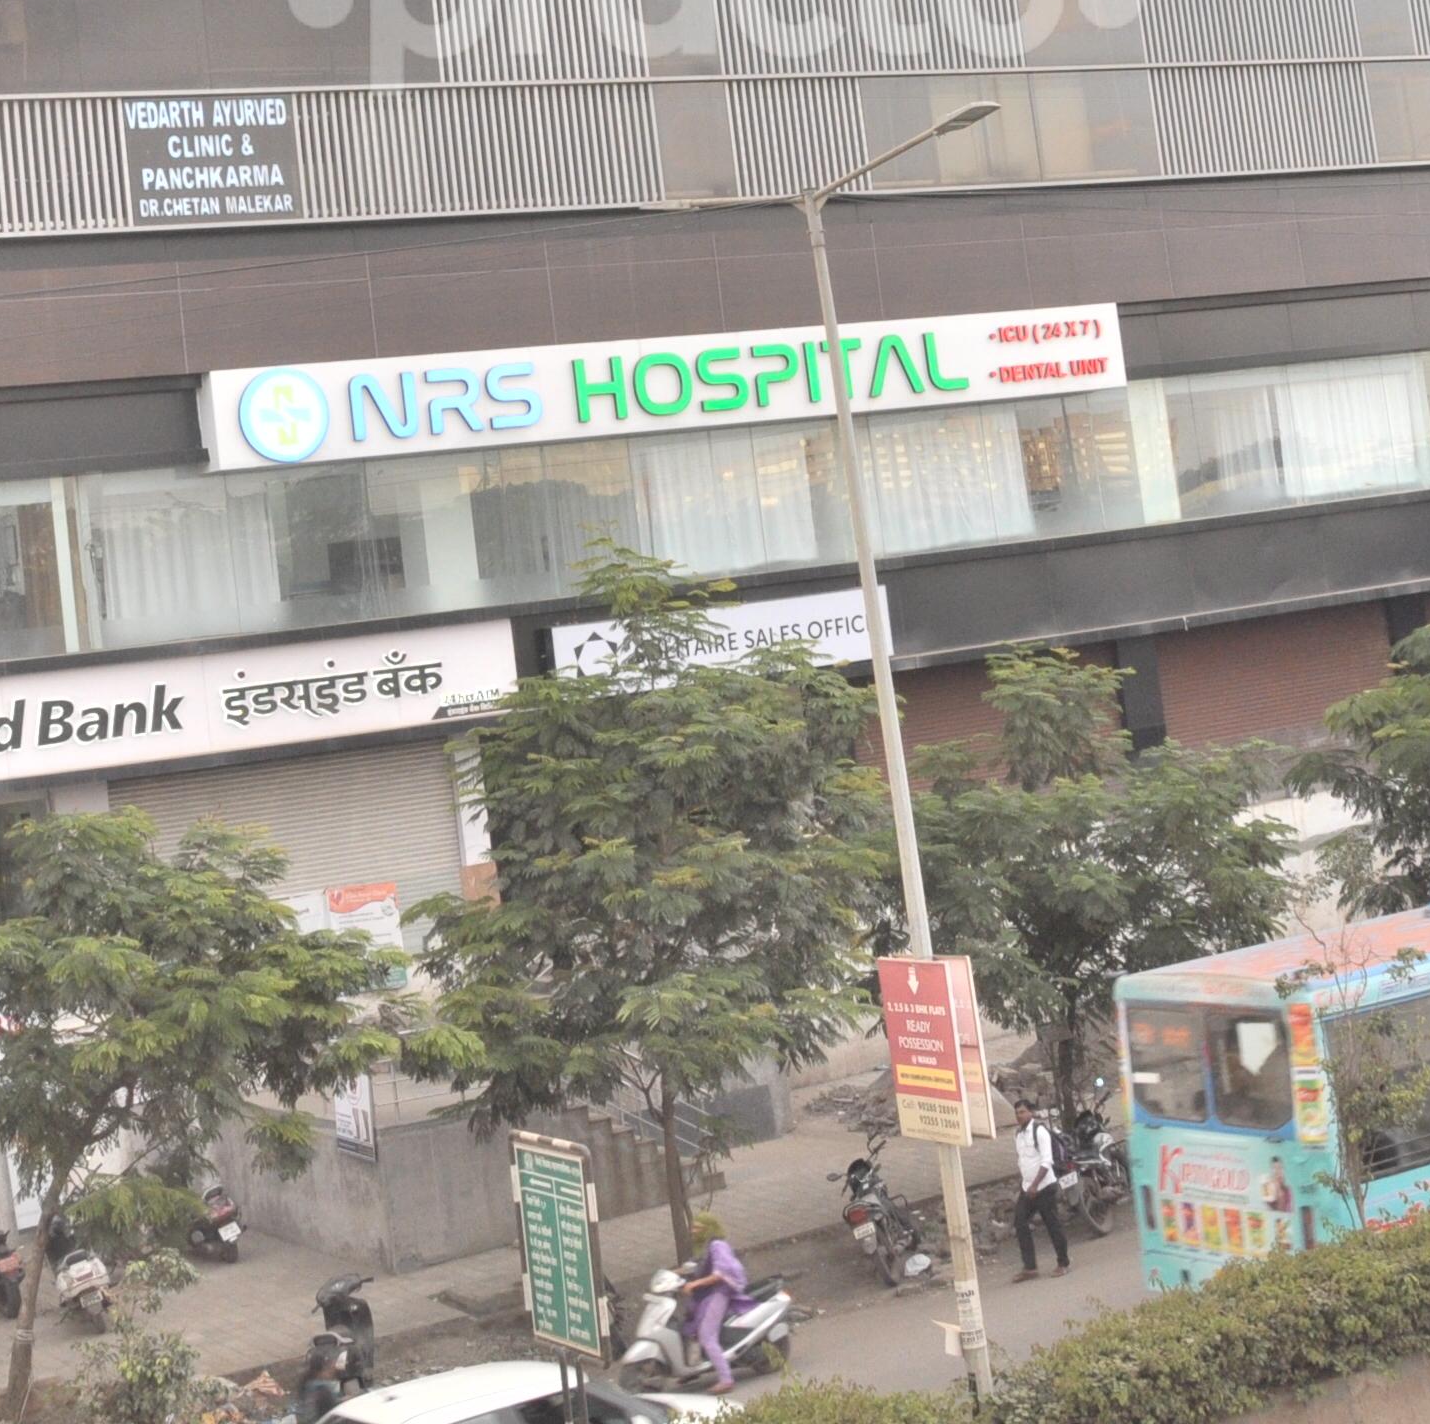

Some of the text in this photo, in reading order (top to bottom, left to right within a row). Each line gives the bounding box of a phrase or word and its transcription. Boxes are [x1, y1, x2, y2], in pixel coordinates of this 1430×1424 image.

[124, 98, 287, 130] VEDARTH AYURVED
[167, 133, 254, 158] CLINIC &
[141, 164, 284, 191] PANCHKARMA
[225, 193, 294, 214] MALEKAR
[998, 325, 1028, 343] ICU
[999, 357, 1108, 383] DENTAL UNIT
[348, 332, 971, 443] NRS HOSPITAL
[744, 625, 802, 649] SALES
[807, 615, 867, 641] OFFIC
[37, 684, 184, 746] Bank
[906, 1019, 930, 1033] READY
